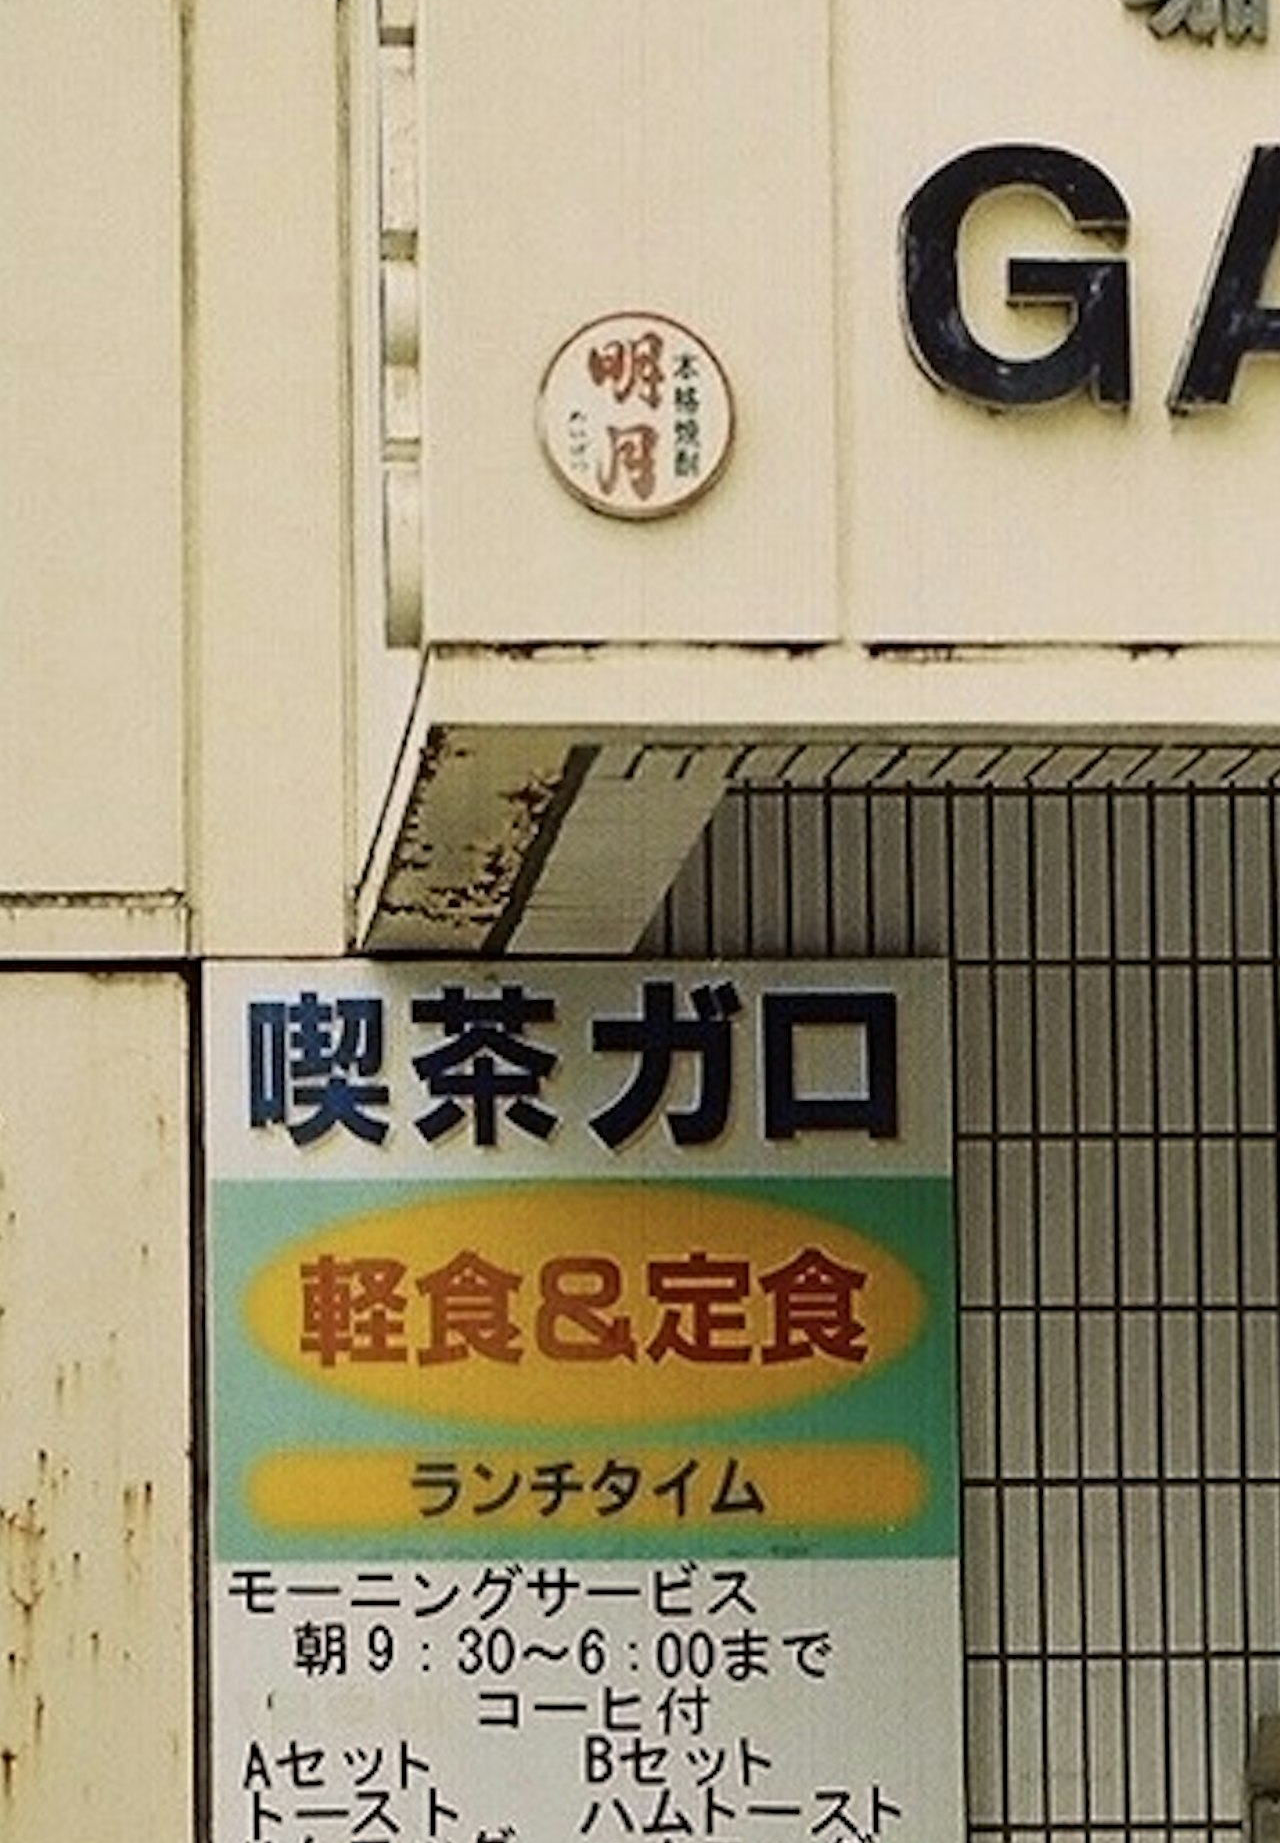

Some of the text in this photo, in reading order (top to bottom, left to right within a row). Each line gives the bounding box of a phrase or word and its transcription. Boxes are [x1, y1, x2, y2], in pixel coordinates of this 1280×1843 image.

[246, 980, 900, 1150] 喫茶ガロ
[298, 1248, 870, 1368] 軽食&定食
[410, 1456, 767, 1519] ランチタイム
[228, 1561, 757, 1620] モーニングサービス
[478, 1684, 711, 1736] コーヒ付
[243, 1740, 430, 1790] Aセット
[585, 1735, 773, 1787] Bセット
[253, 1787, 459, 1841] トースト
[580, 1785, 903, 1835] ハムトースト
